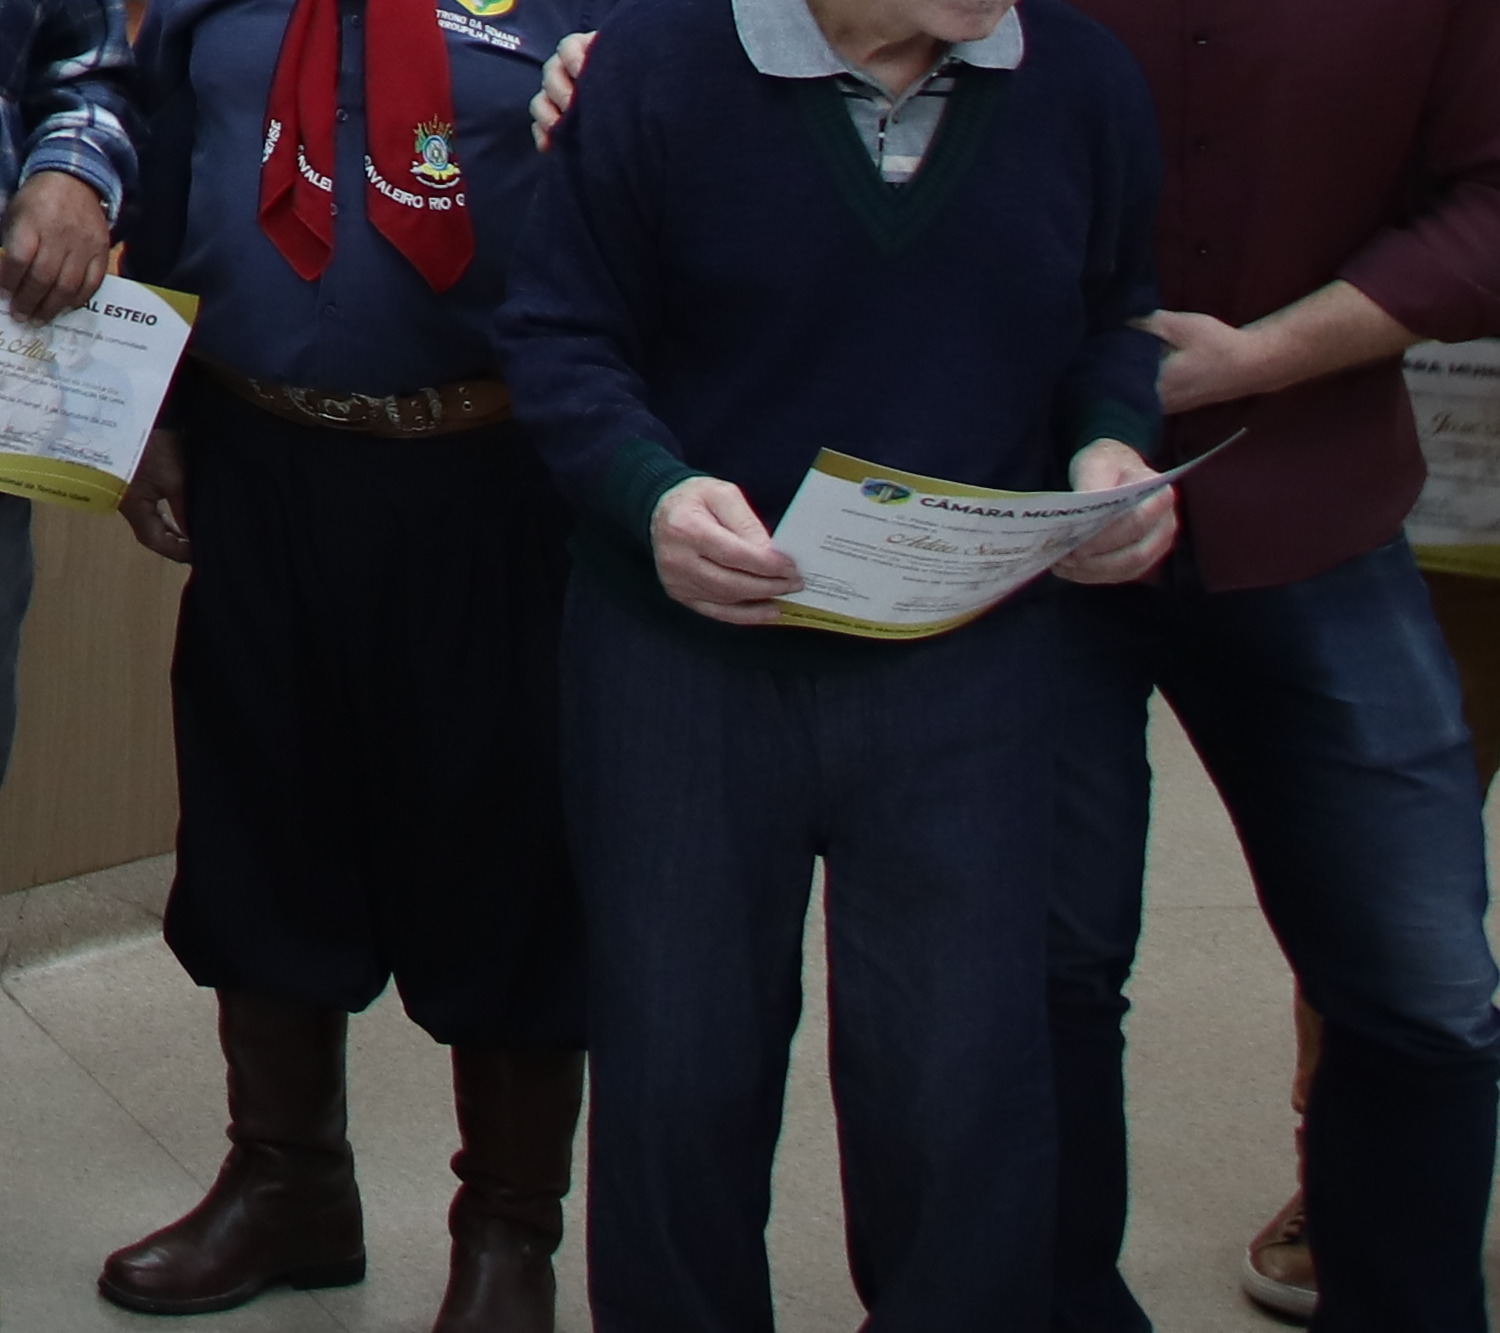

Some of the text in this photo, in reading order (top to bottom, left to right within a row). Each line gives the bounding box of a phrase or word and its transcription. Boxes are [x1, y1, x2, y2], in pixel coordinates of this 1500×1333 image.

[364, 154, 424, 209] CAVALEIRO
[428, 196, 451, 211] RIO
[103, 303, 158, 326] ESTEIO
[920, 498, 1015, 518] CÂMARA
